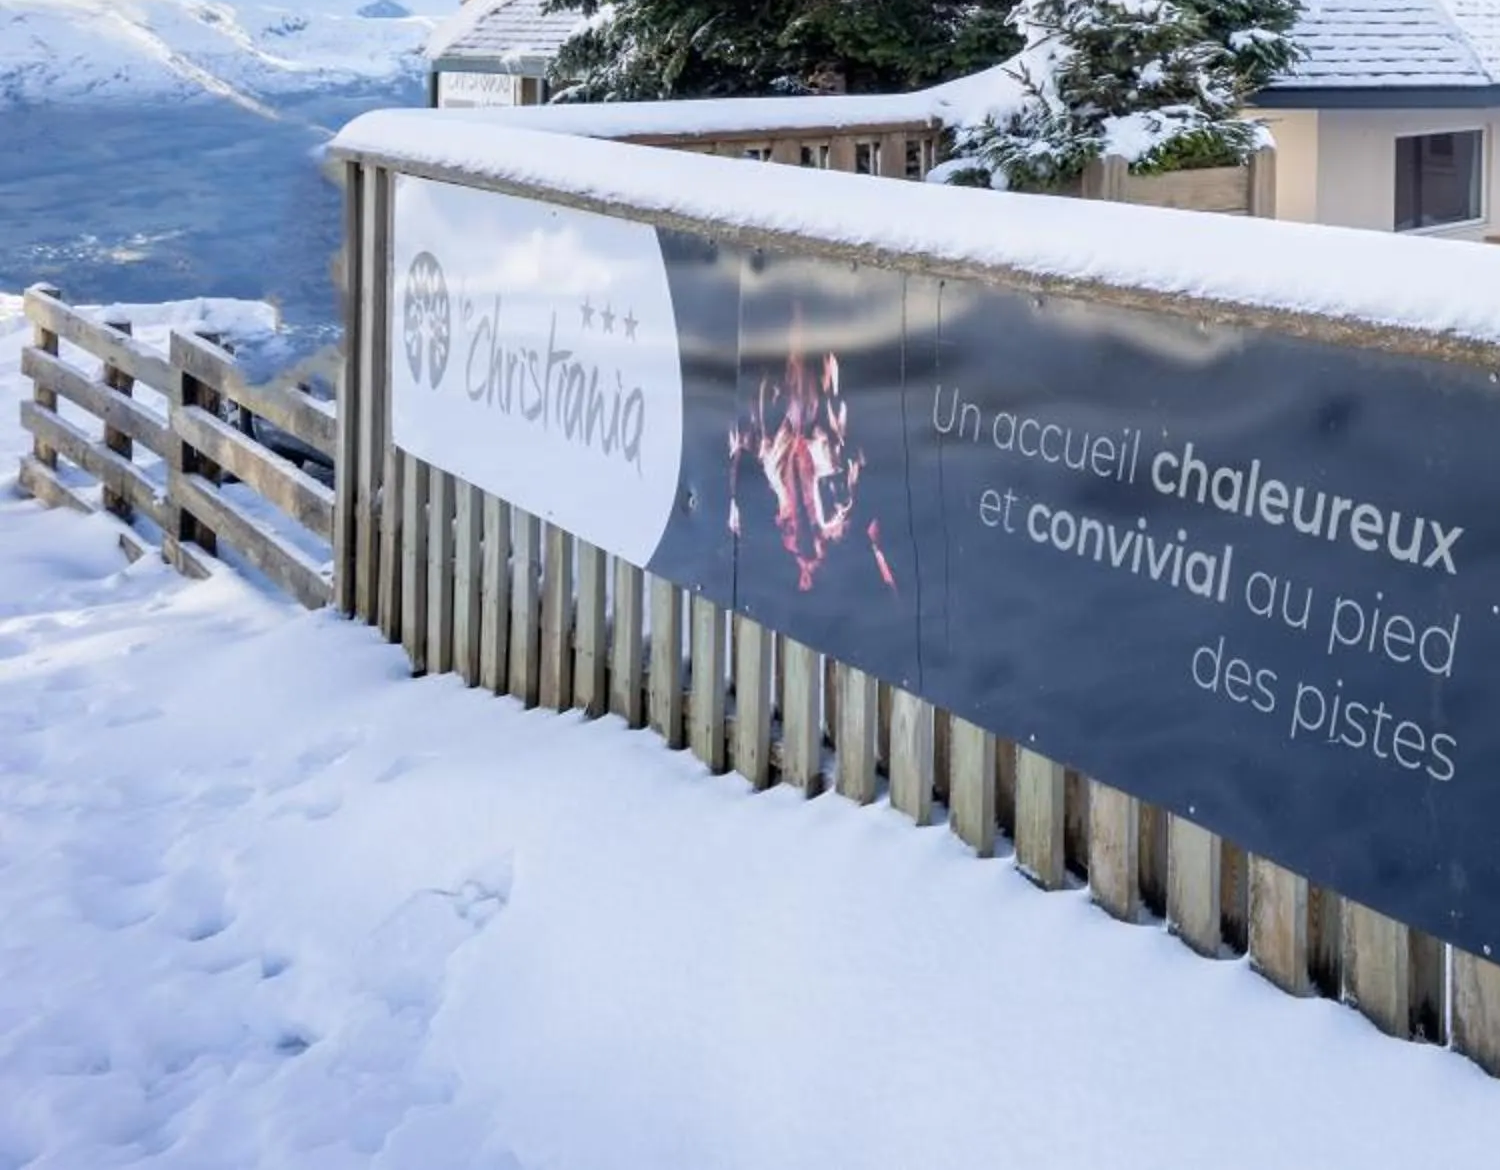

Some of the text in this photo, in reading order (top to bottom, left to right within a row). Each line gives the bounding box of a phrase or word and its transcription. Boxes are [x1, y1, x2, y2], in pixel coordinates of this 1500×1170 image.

[466, 293, 645, 479] Christiania
[932, 386, 1465, 574] Un accueil chaleureux
[979, 487, 1461, 678] et convivial au pied
[1191, 636, 1458, 782] des pistes
